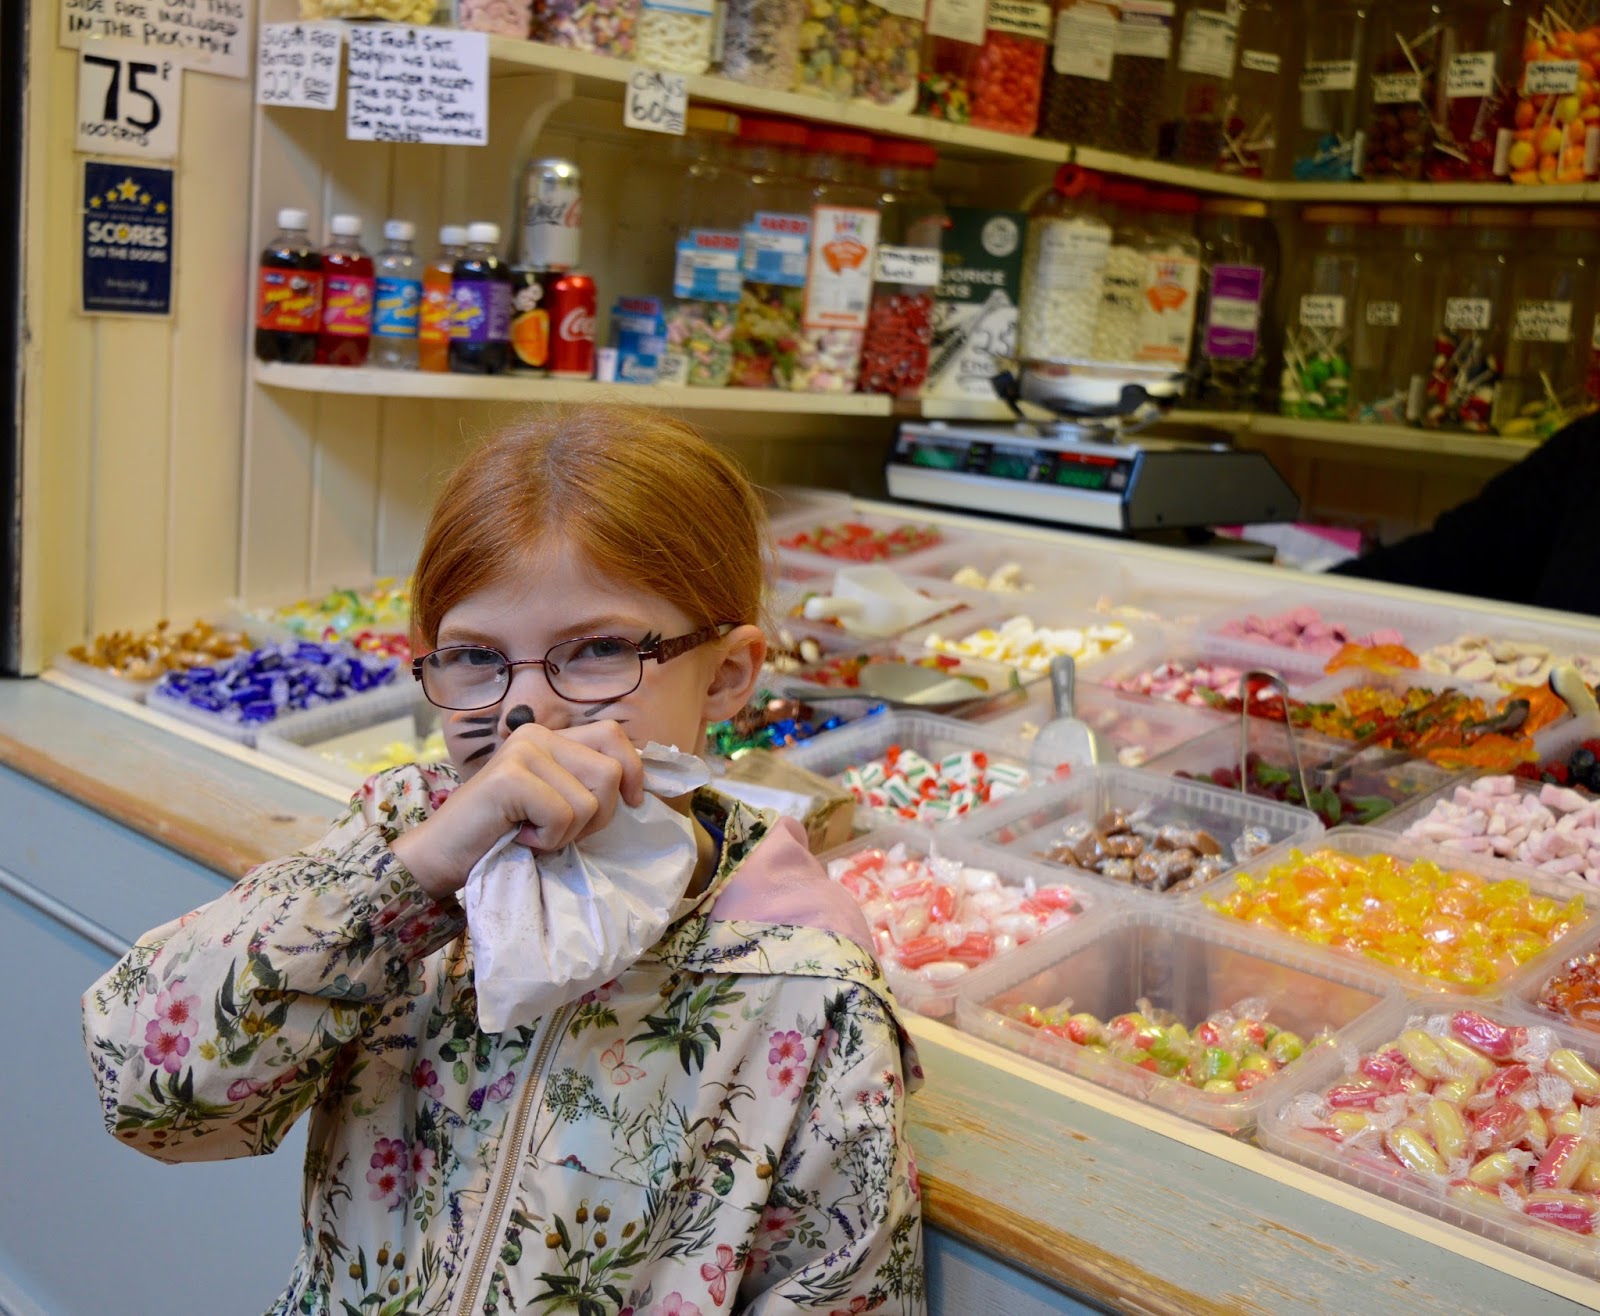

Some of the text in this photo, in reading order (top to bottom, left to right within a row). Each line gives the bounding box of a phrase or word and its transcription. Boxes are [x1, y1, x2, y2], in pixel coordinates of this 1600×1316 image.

[69, 15, 92, 31] IN
[98, 20, 136, 38] THE
[115, 1, 147, 19] ARE
[159, 10, 238, 36] INCLUDED
[87, 220, 168, 248] SCORES
[941, 268, 1006, 285] ORICE
